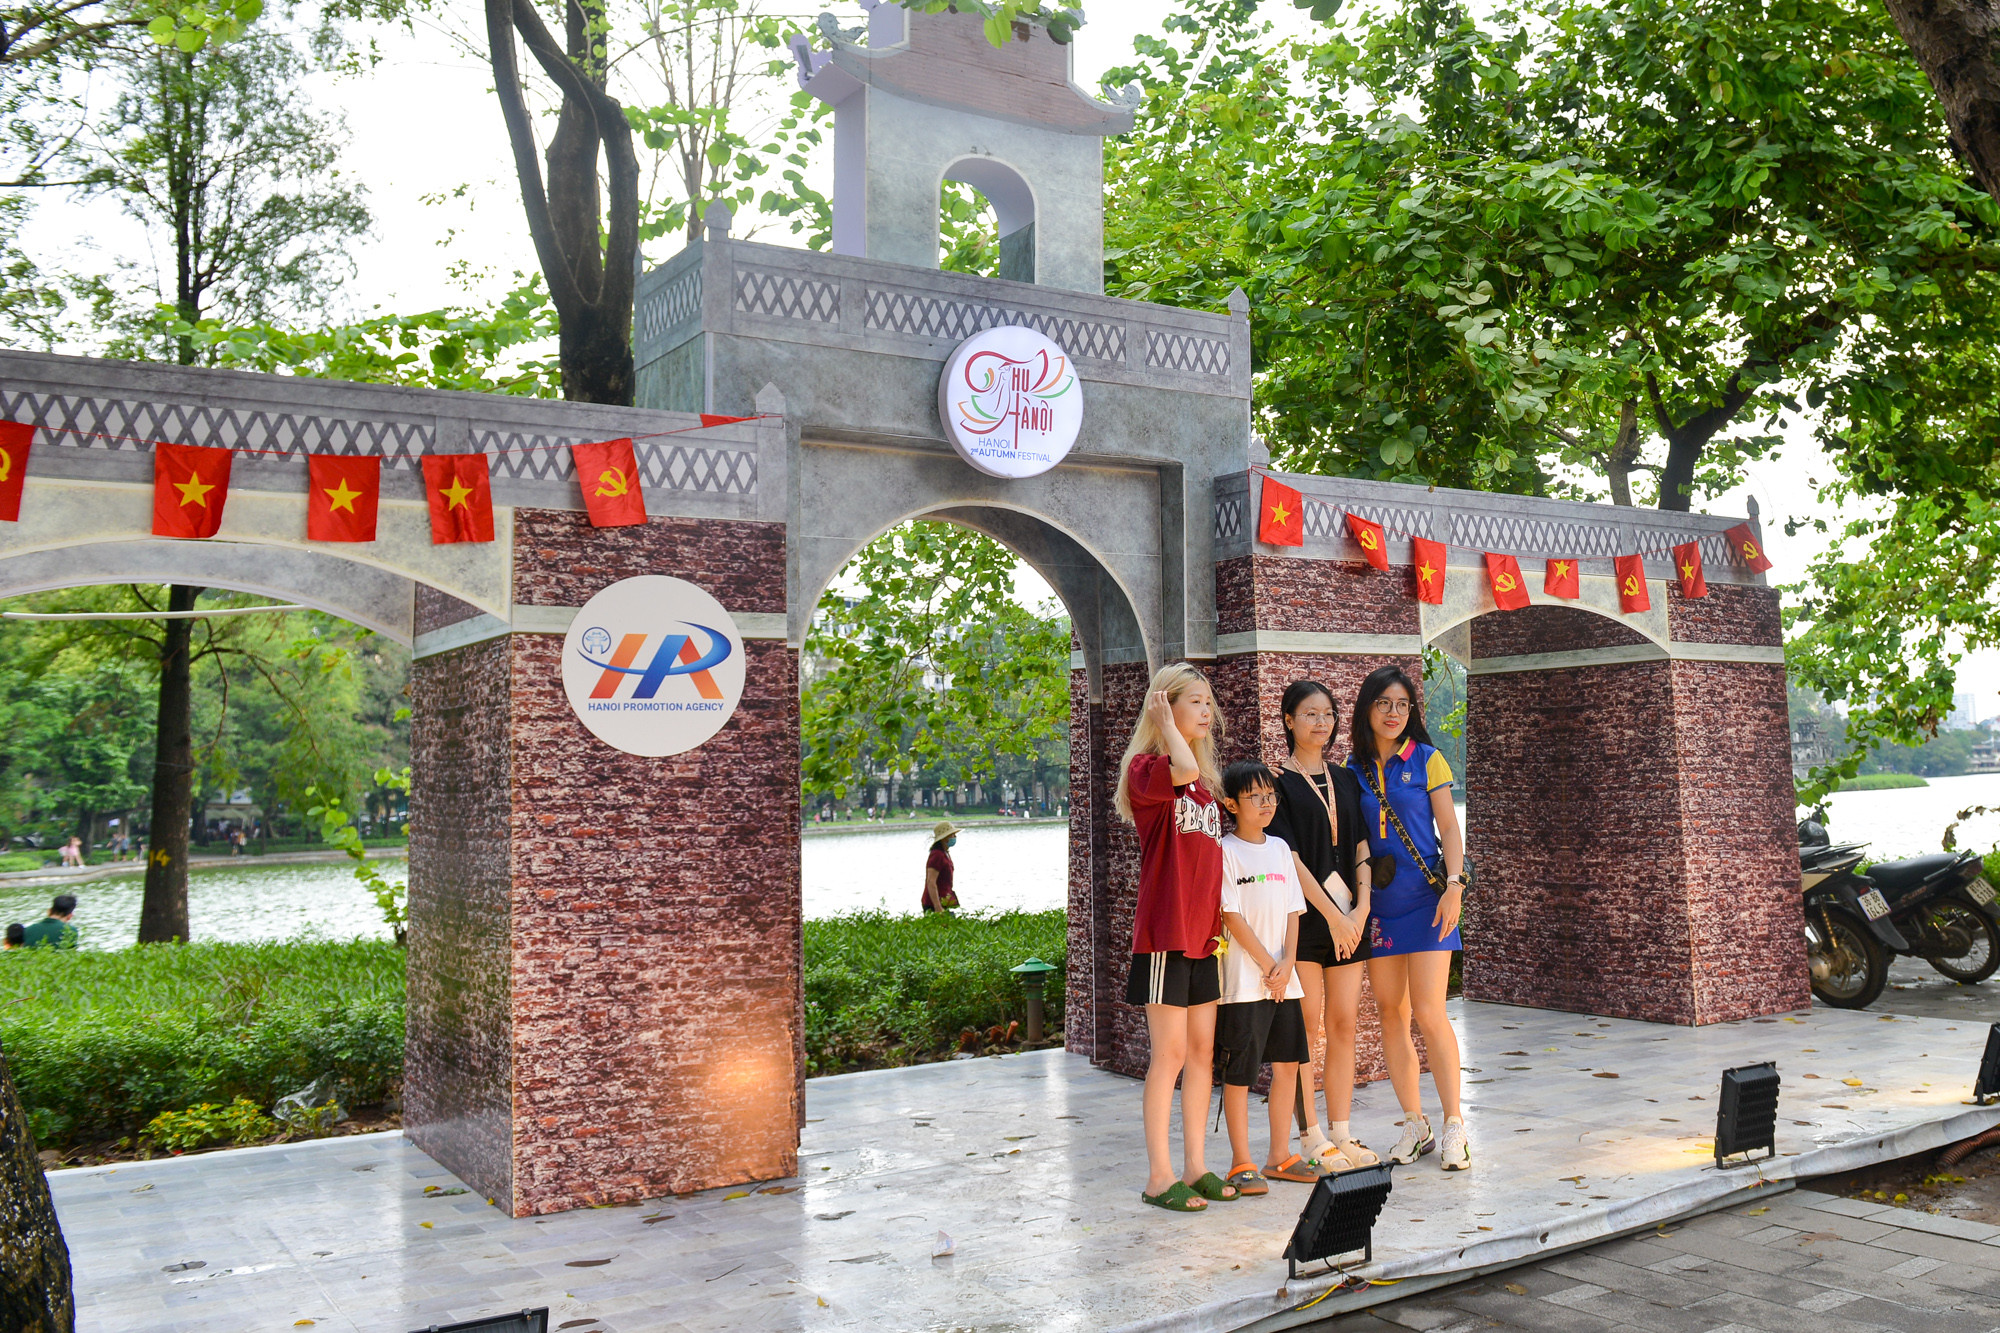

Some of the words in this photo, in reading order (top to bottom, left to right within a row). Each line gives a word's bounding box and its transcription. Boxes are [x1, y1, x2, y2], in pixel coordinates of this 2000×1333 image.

[978, 437, 1011, 449] HANOI
[978, 448, 1016, 459] AUTUMN
[1017, 452, 1052, 463] FESTIVAL
[588, 702, 621, 711] HANOI
[623, 702, 683, 711] PROMOTION
[685, 703, 724, 711] AGENCY
